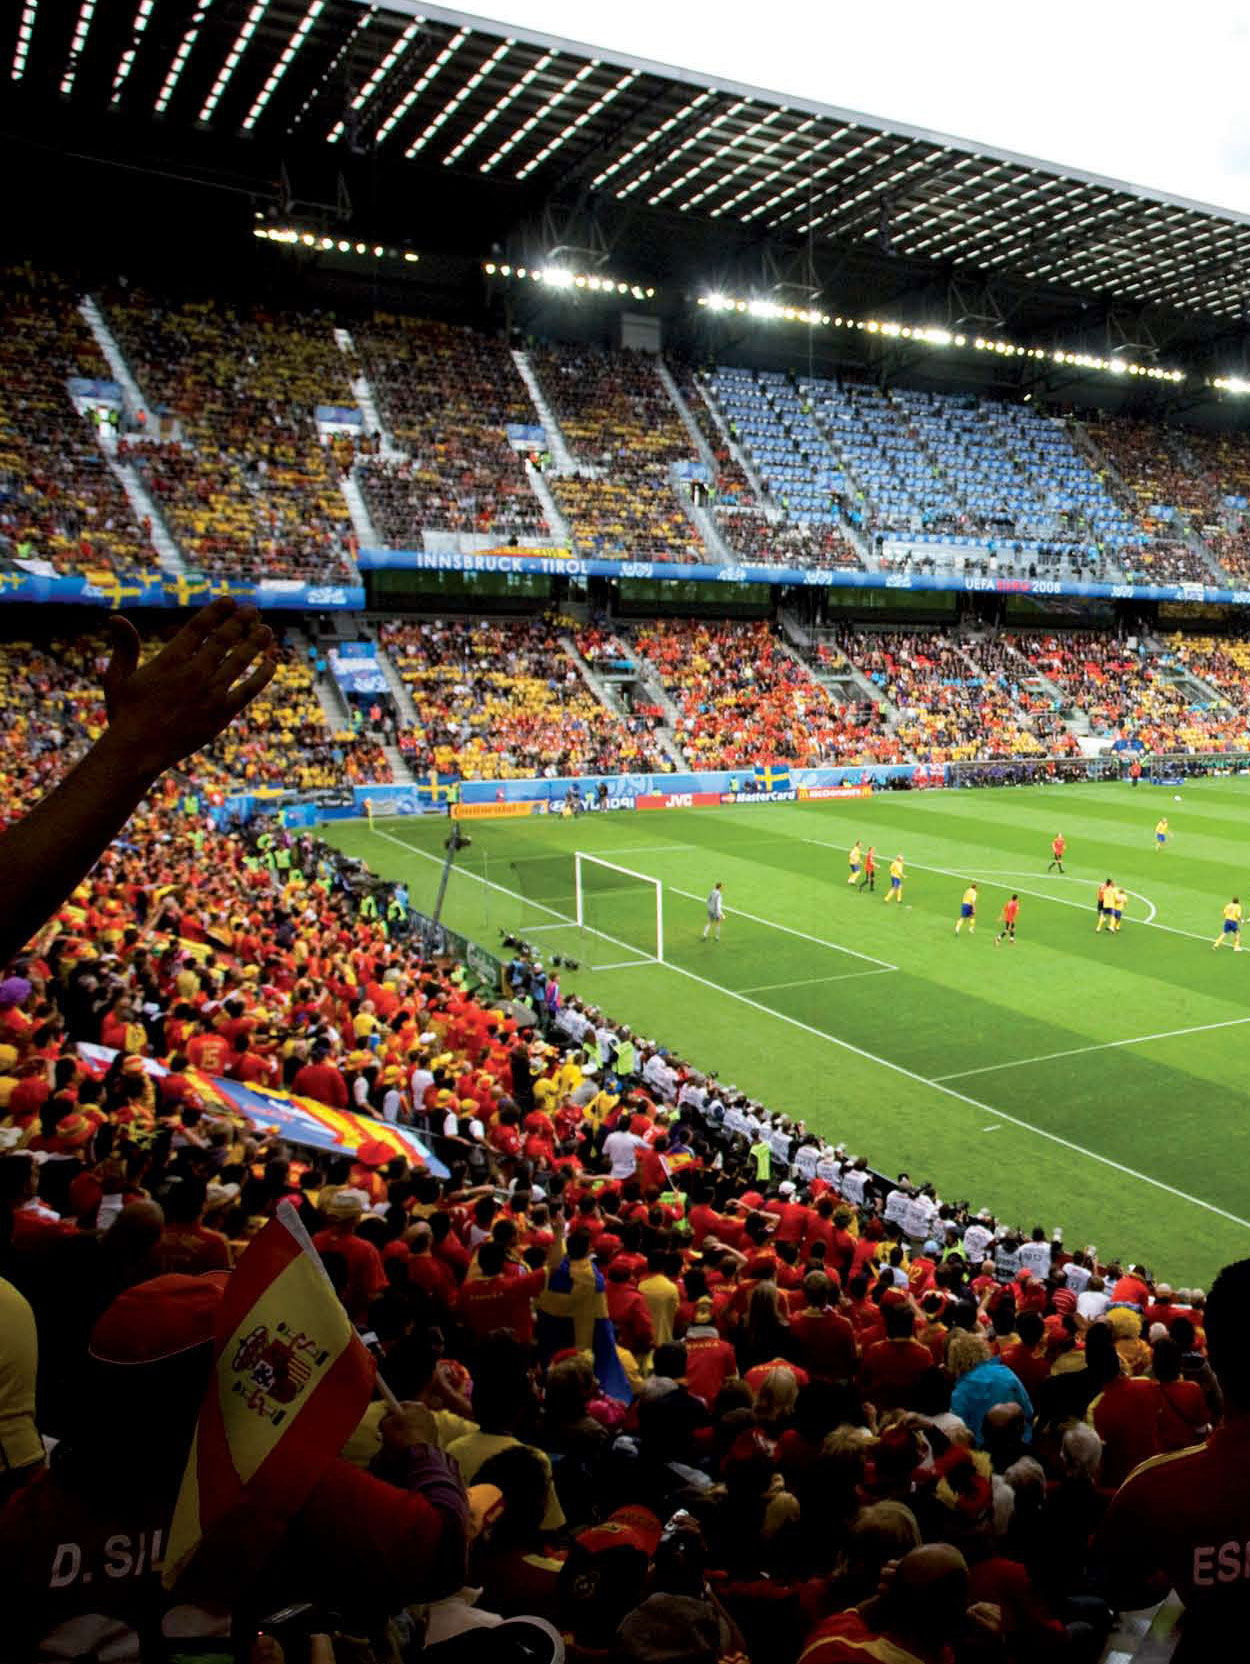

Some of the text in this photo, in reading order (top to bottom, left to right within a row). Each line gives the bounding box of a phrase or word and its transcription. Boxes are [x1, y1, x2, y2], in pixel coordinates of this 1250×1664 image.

[417, 553, 522, 572] INNSBRUCK
[541, 558, 588, 574] TIROL
[965, 577, 995, 591] UEFA
[1031, 580, 1062, 593] 2008
[665, 793, 693, 808] JVC
[736, 790, 796, 803] MasterCard
[50, 1530, 165, 1588] D. SIL
